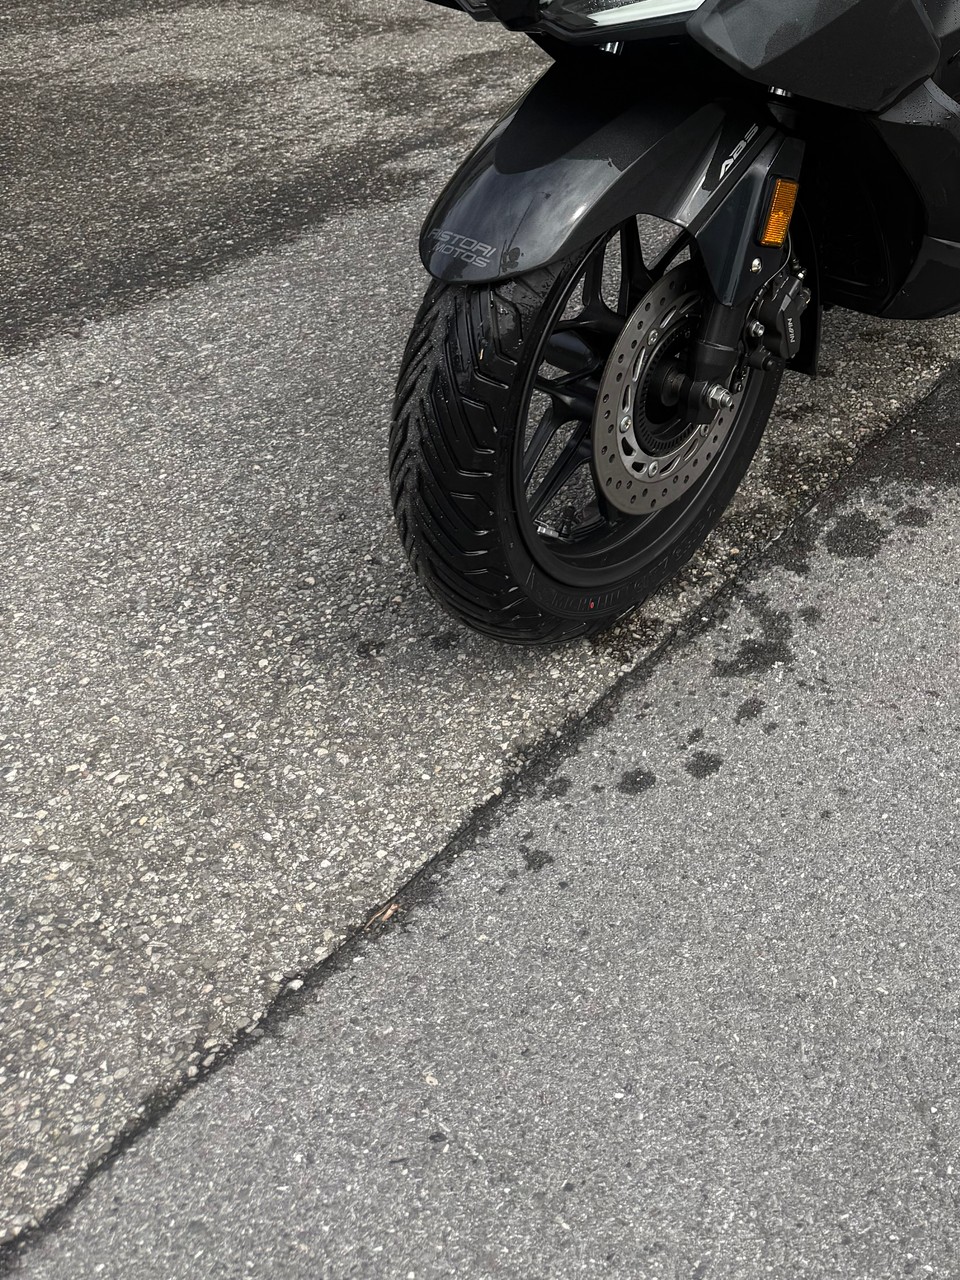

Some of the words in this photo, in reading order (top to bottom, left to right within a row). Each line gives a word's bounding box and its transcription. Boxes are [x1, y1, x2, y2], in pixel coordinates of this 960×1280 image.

[718, 123, 759, 181] ABS
[427, 228, 497, 257] RISTORI
[432, 242, 491, 268] MOTOS
